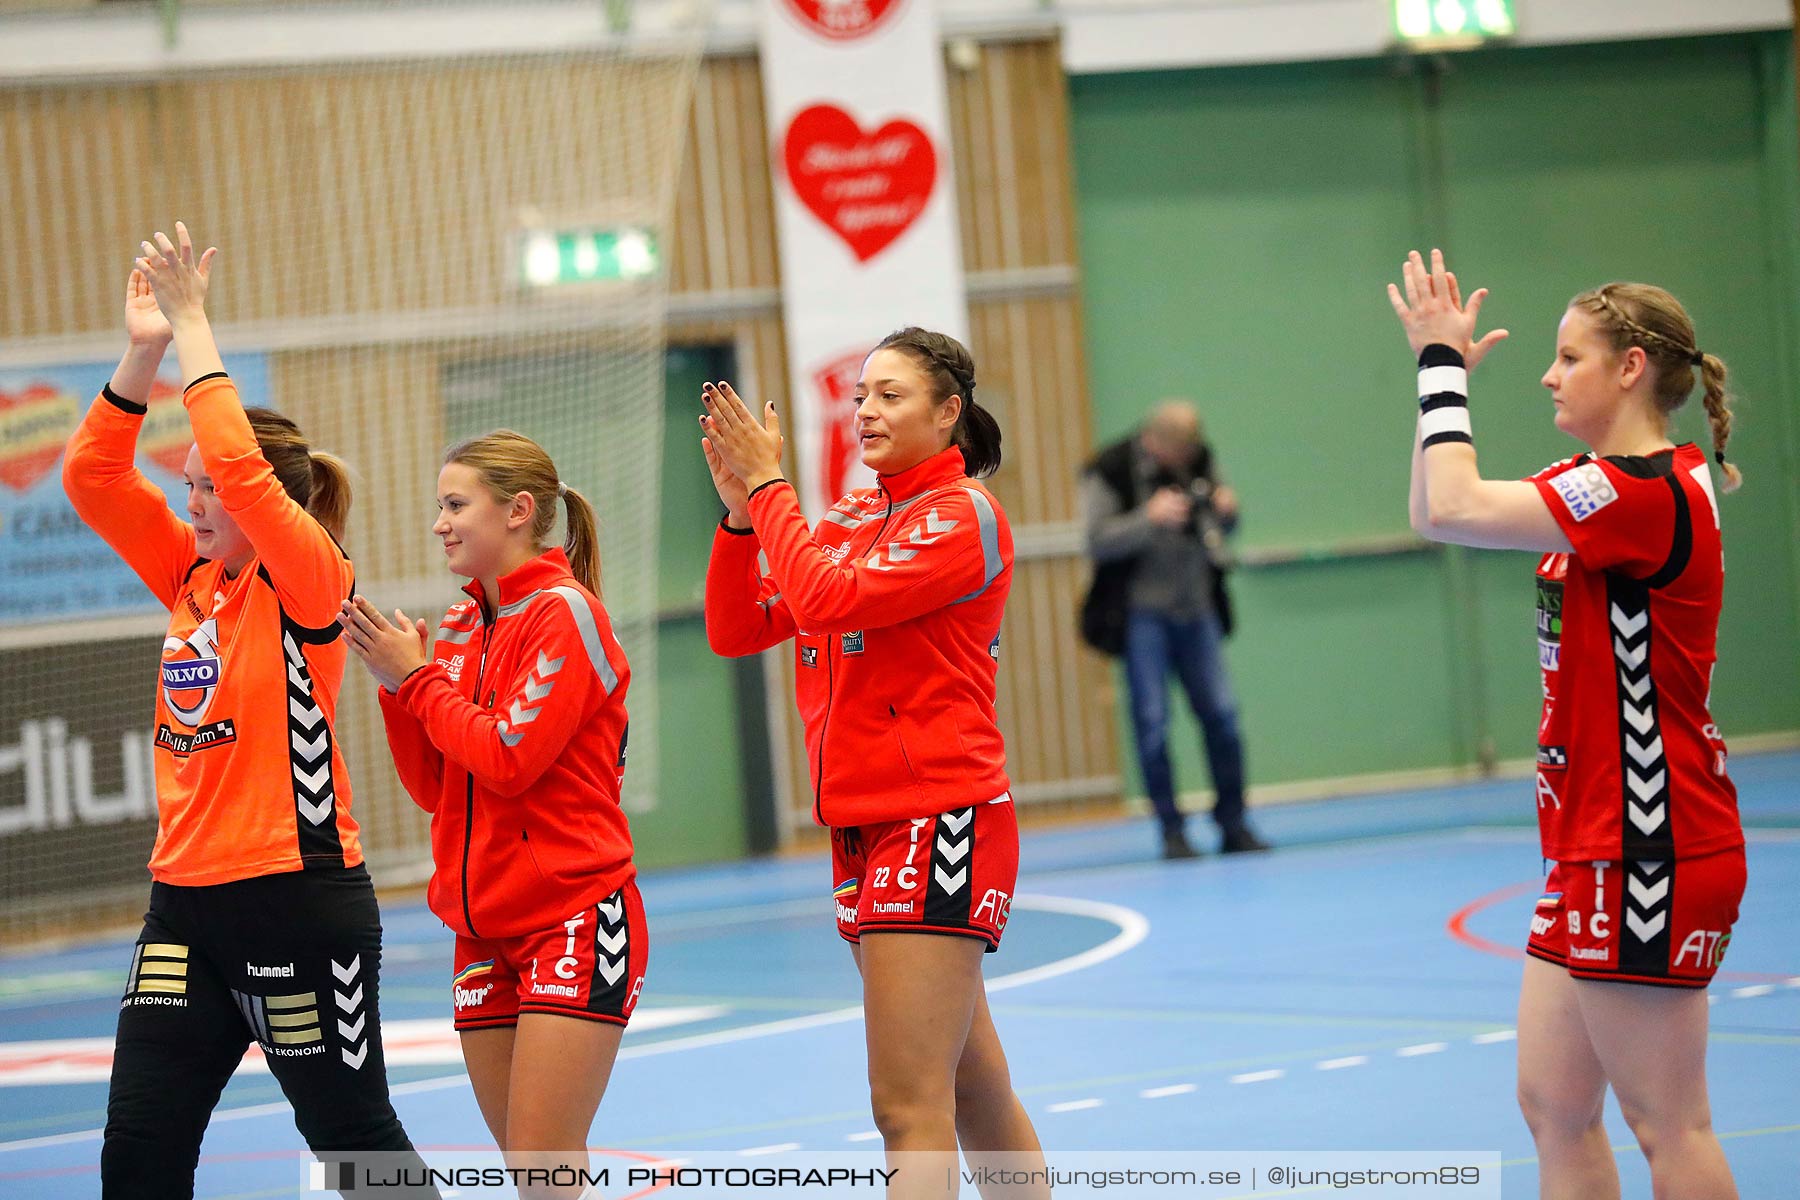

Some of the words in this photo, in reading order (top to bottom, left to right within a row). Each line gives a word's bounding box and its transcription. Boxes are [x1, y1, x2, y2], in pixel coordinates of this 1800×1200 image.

[0, 716, 157, 834] diu
[873, 866, 890, 888] 22
[873, 900, 914, 913] hummel
[247, 962, 294, 978] hummel
[531, 982, 579, 997] hummel
[134, 997, 188, 1008] EKONOMI
[275, 1045, 326, 1057] EKONOMI
